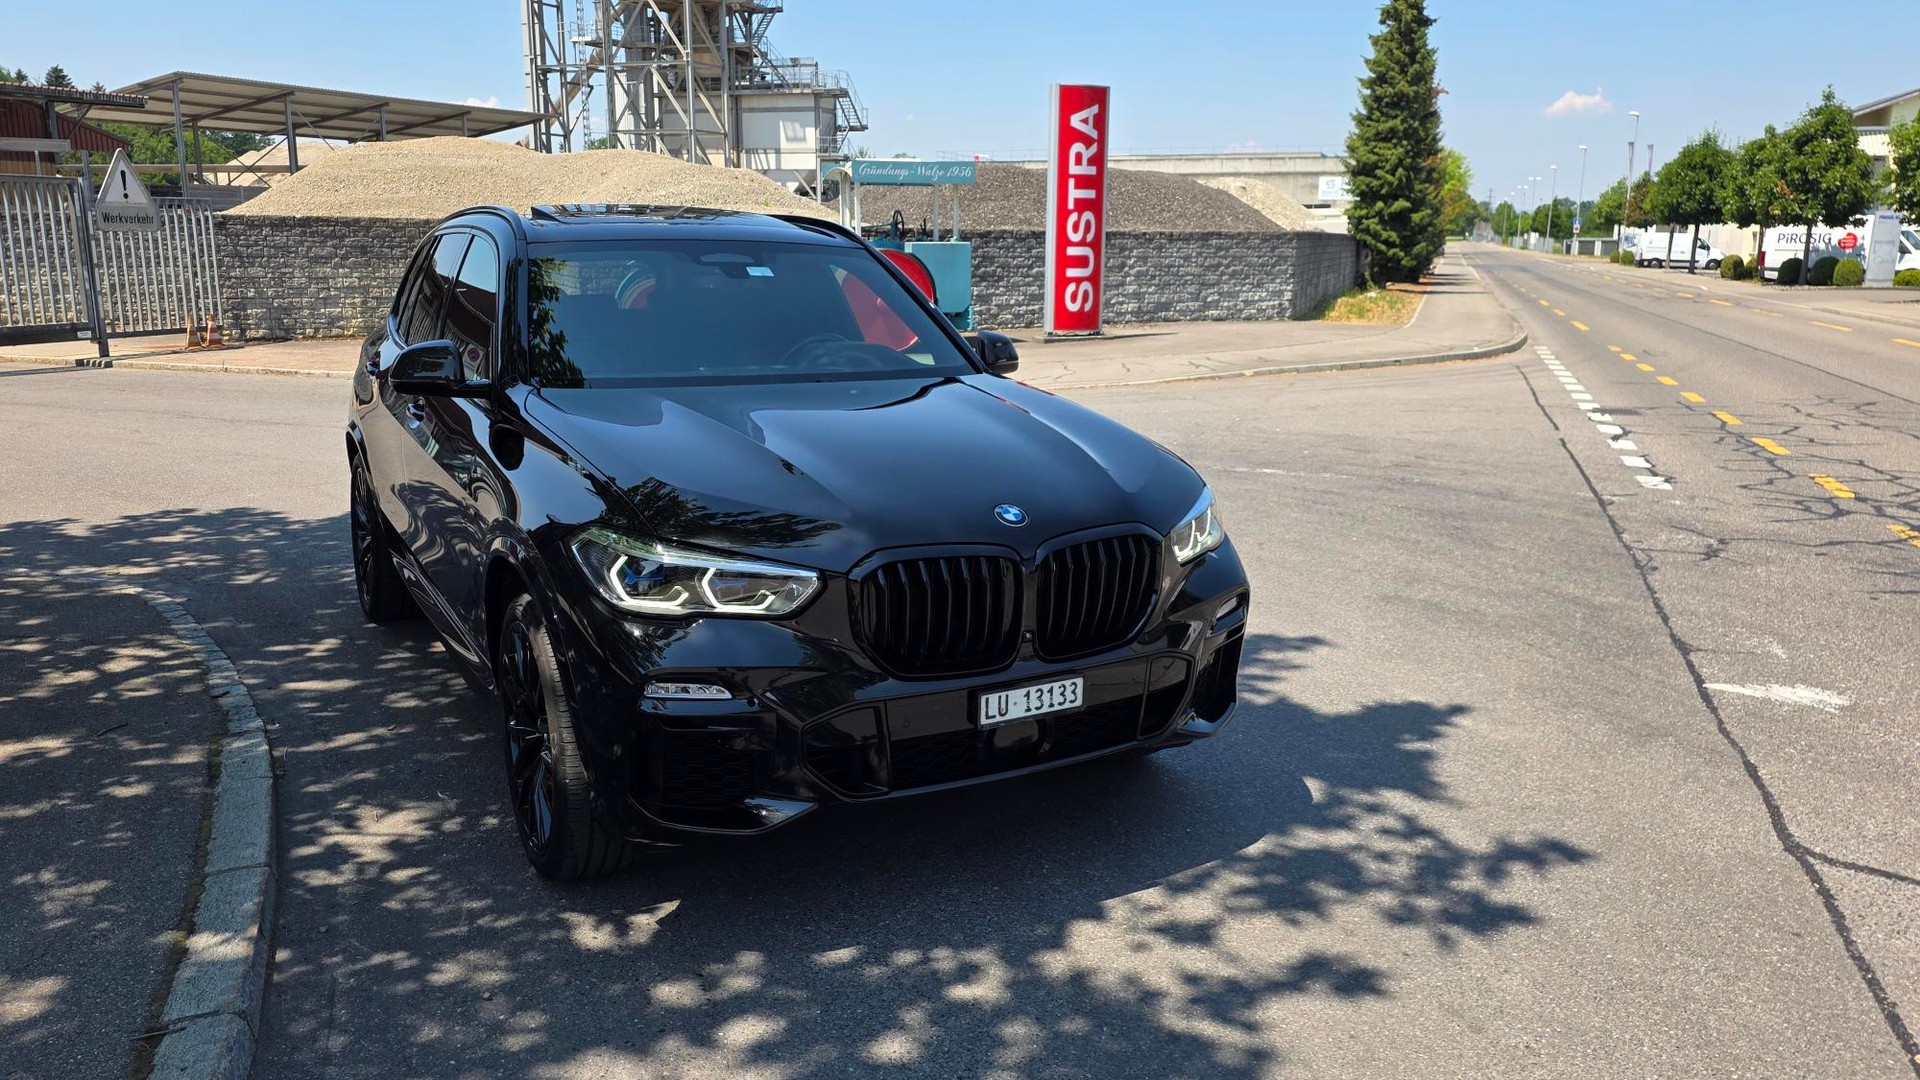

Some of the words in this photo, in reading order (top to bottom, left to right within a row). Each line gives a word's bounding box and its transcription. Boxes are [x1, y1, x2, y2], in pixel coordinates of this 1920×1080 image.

[946, 165, 974, 177] 1956
[101, 211, 154, 224] Werkverkehr
[1064, 103, 1099, 312] SUSTRA
[984, 693, 1009, 720] LU
[1023, 681, 1078, 713] 13133
